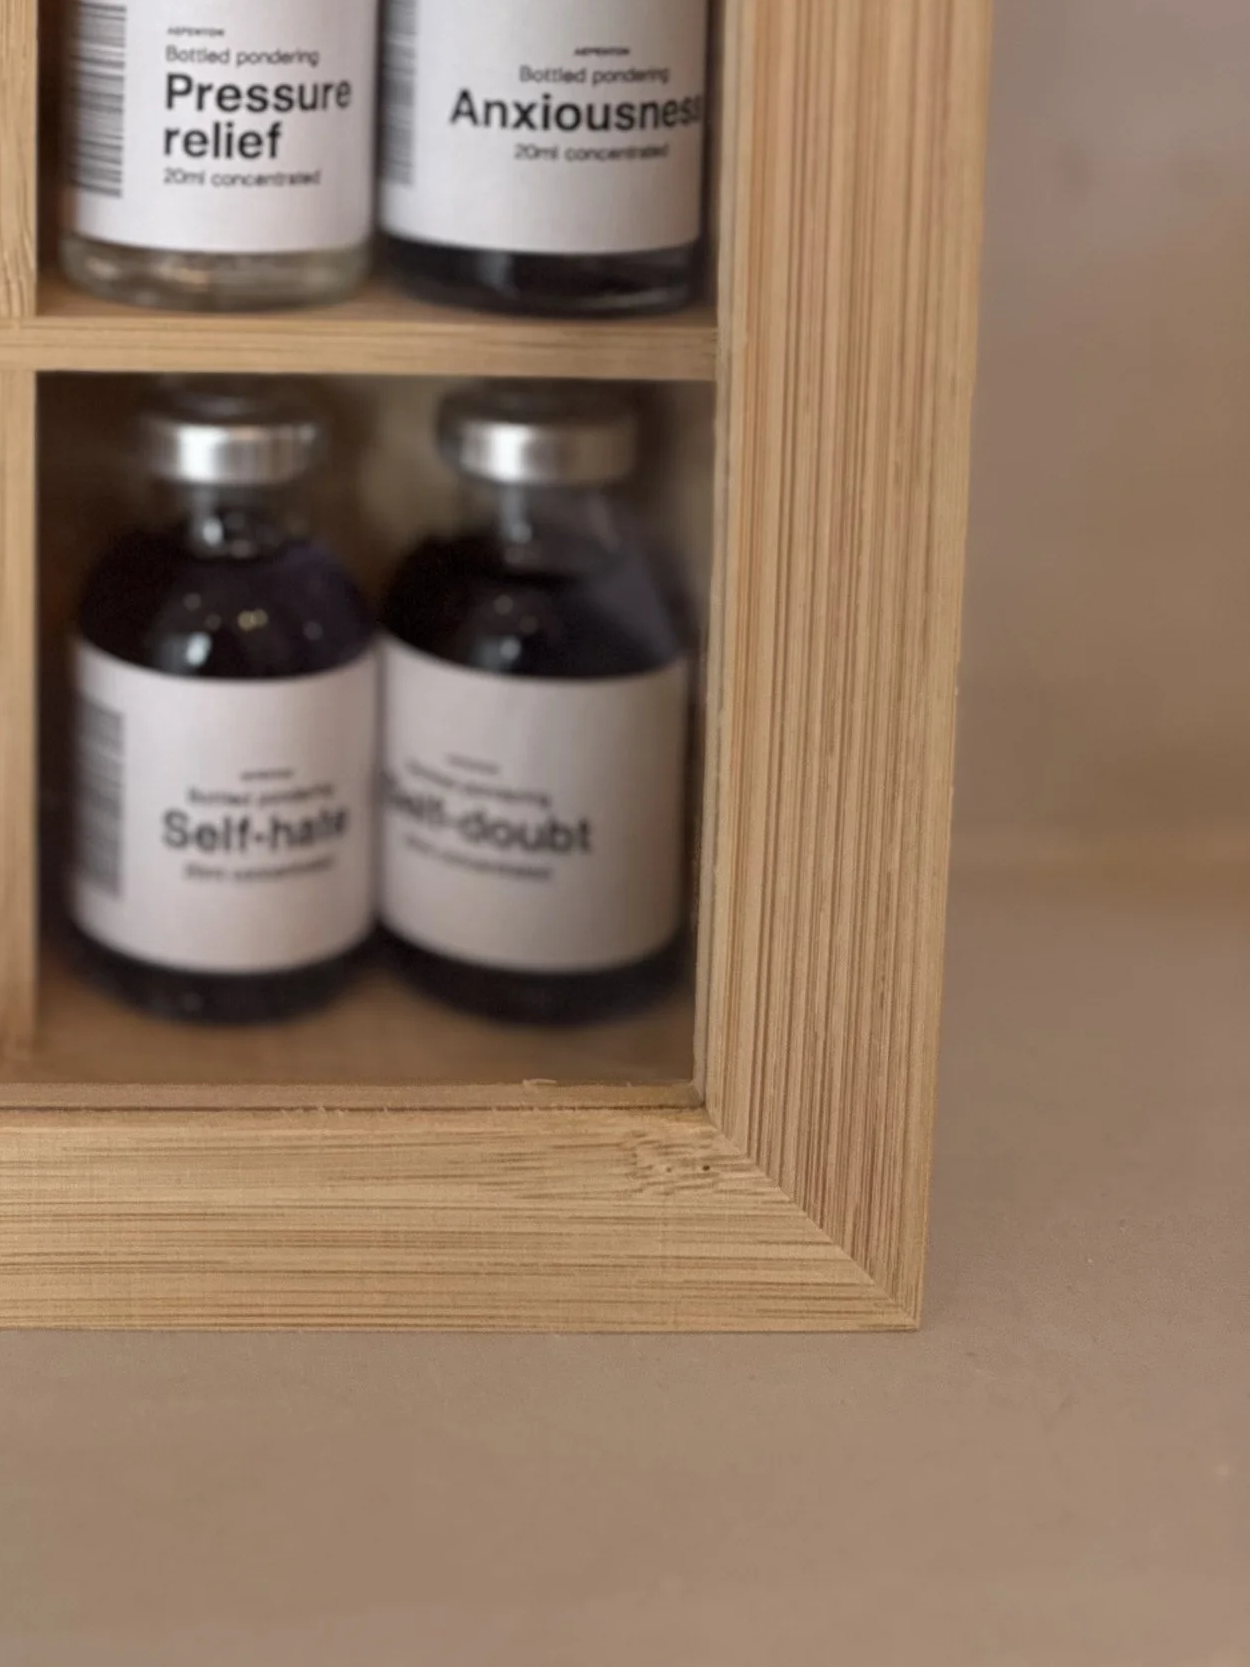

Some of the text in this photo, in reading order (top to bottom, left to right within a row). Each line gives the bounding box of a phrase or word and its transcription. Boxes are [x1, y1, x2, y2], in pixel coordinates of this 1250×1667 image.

[165, 45, 320, 67] Bottled pondering
[519, 65, 587, 84] Bottled
[165, 73, 352, 113] Pressure
[163, 121, 283, 160] relief
[514, 143, 559, 160] 20ml
[163, 169, 205, 185] 20ml
